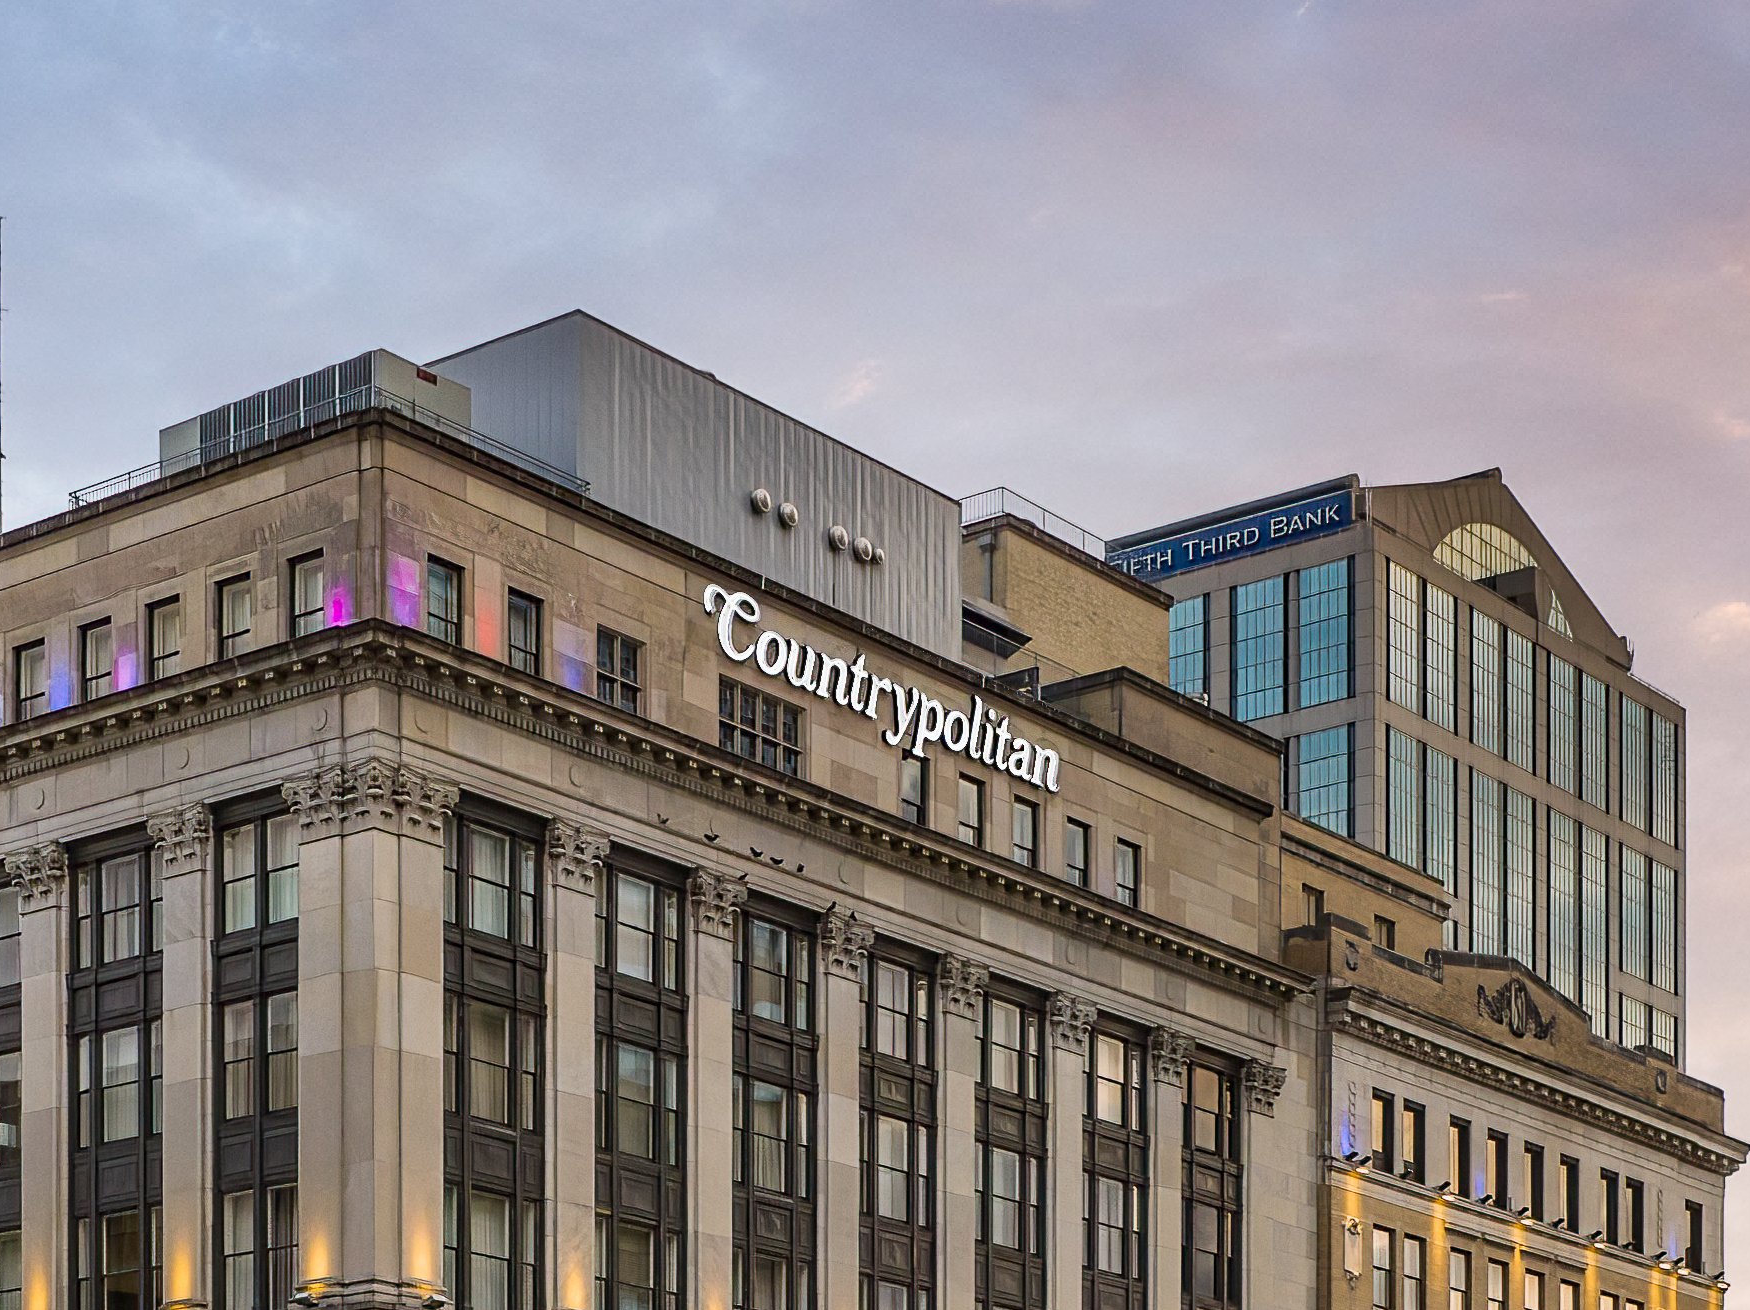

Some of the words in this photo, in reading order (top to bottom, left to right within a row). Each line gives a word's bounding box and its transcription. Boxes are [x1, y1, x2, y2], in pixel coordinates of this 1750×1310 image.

[1182, 527, 1260, 560] THIRD
[1270, 504, 1340, 539] BANK
[703, 583, 1061, 794] Countrypolitan
